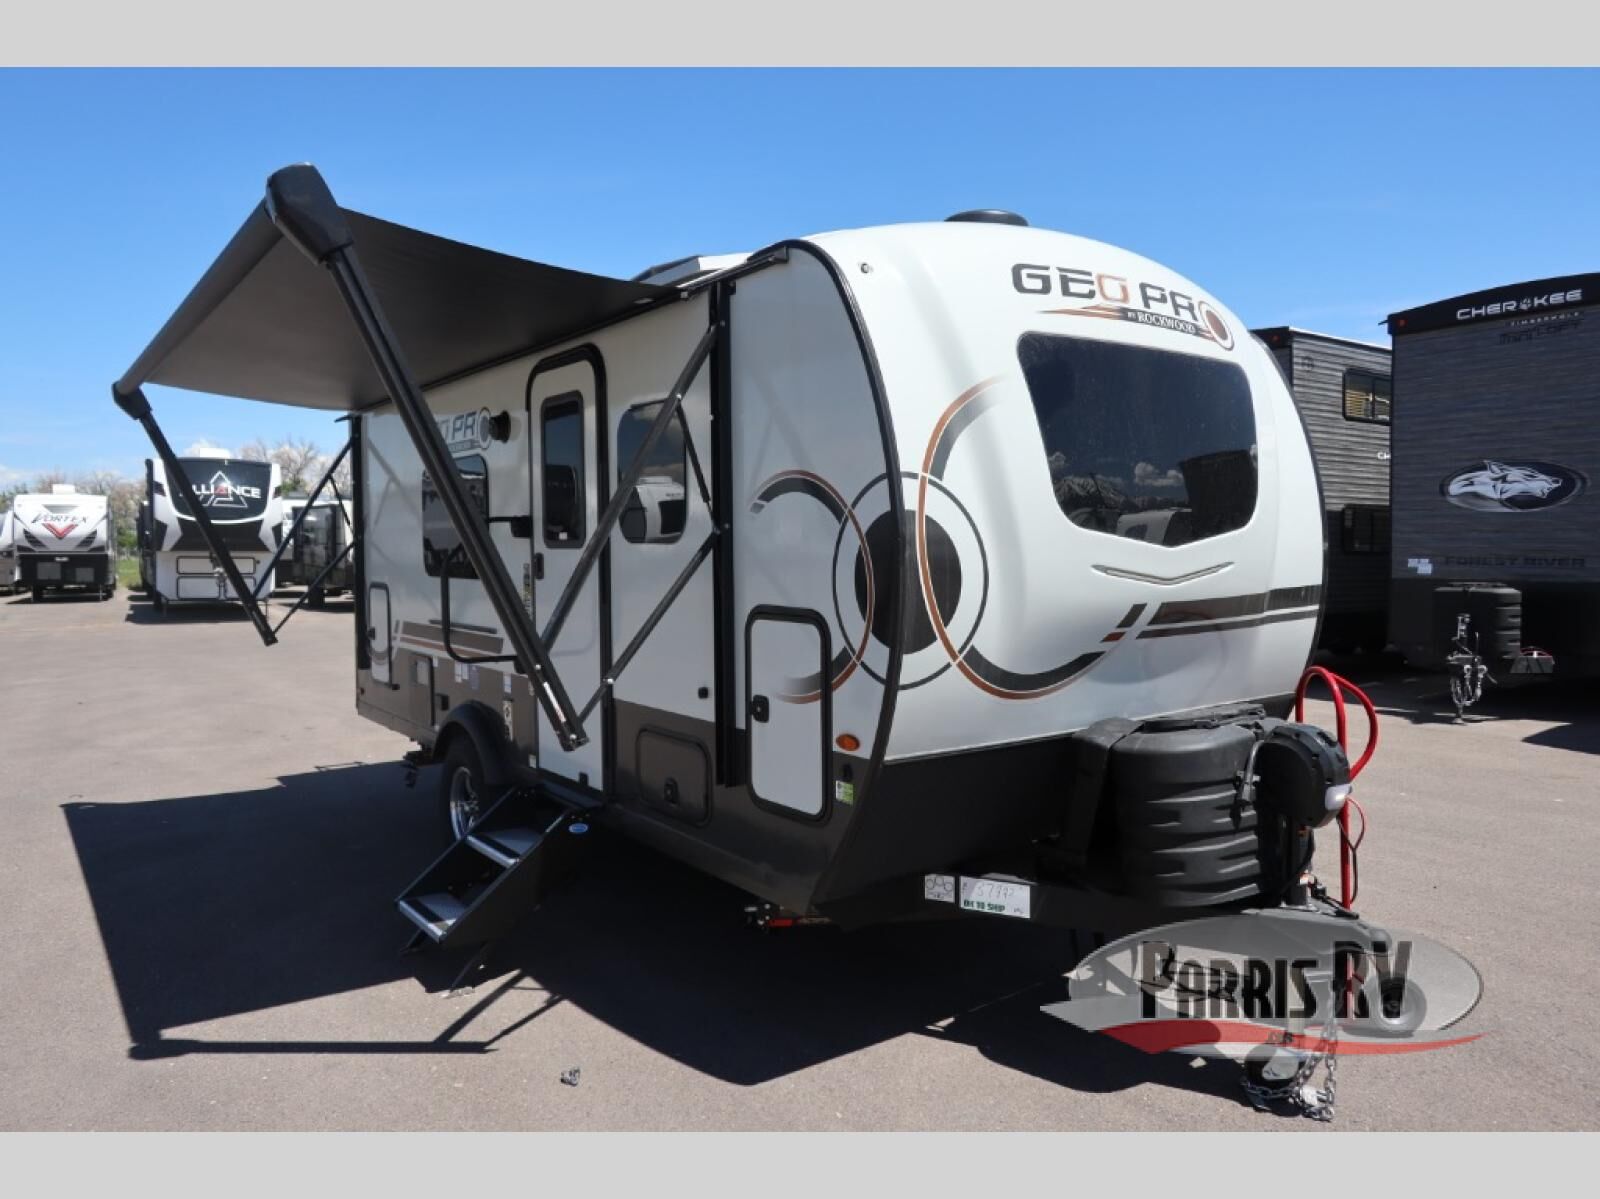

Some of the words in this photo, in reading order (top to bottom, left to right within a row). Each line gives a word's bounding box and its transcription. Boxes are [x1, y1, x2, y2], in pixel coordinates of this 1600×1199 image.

[1011, 263, 1130, 304] GEO
[1139, 282, 1235, 351] PRO
[1456, 288, 1583, 320] CHEROKEE
[1137, 310, 1196, 335] ROCKWOOD
[30, 511, 90, 524] VORTEX
[1444, 555, 1518, 567] FOREST
[1523, 556, 1585, 568] RIVER
